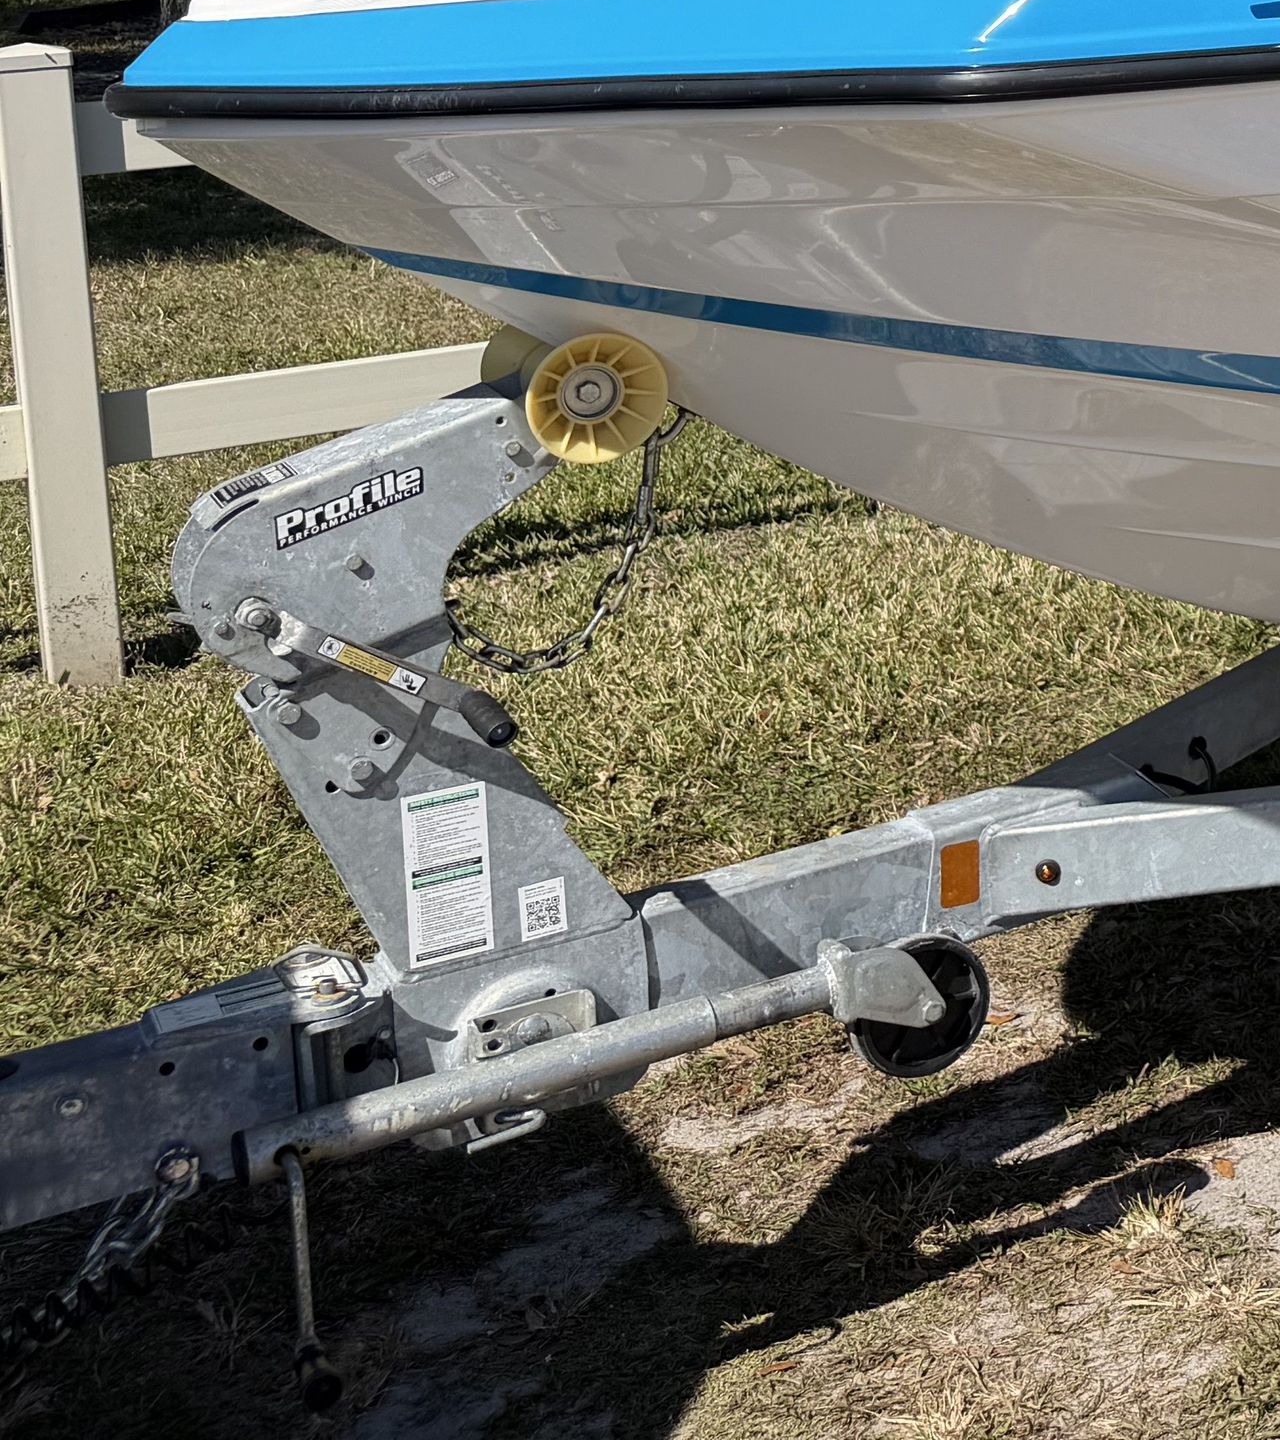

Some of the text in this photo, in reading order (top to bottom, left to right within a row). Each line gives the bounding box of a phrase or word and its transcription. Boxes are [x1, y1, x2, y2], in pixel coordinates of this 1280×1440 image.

[276, 468, 421, 540] Profile
[279, 485, 421, 548] PERFORMANCE WINCH
